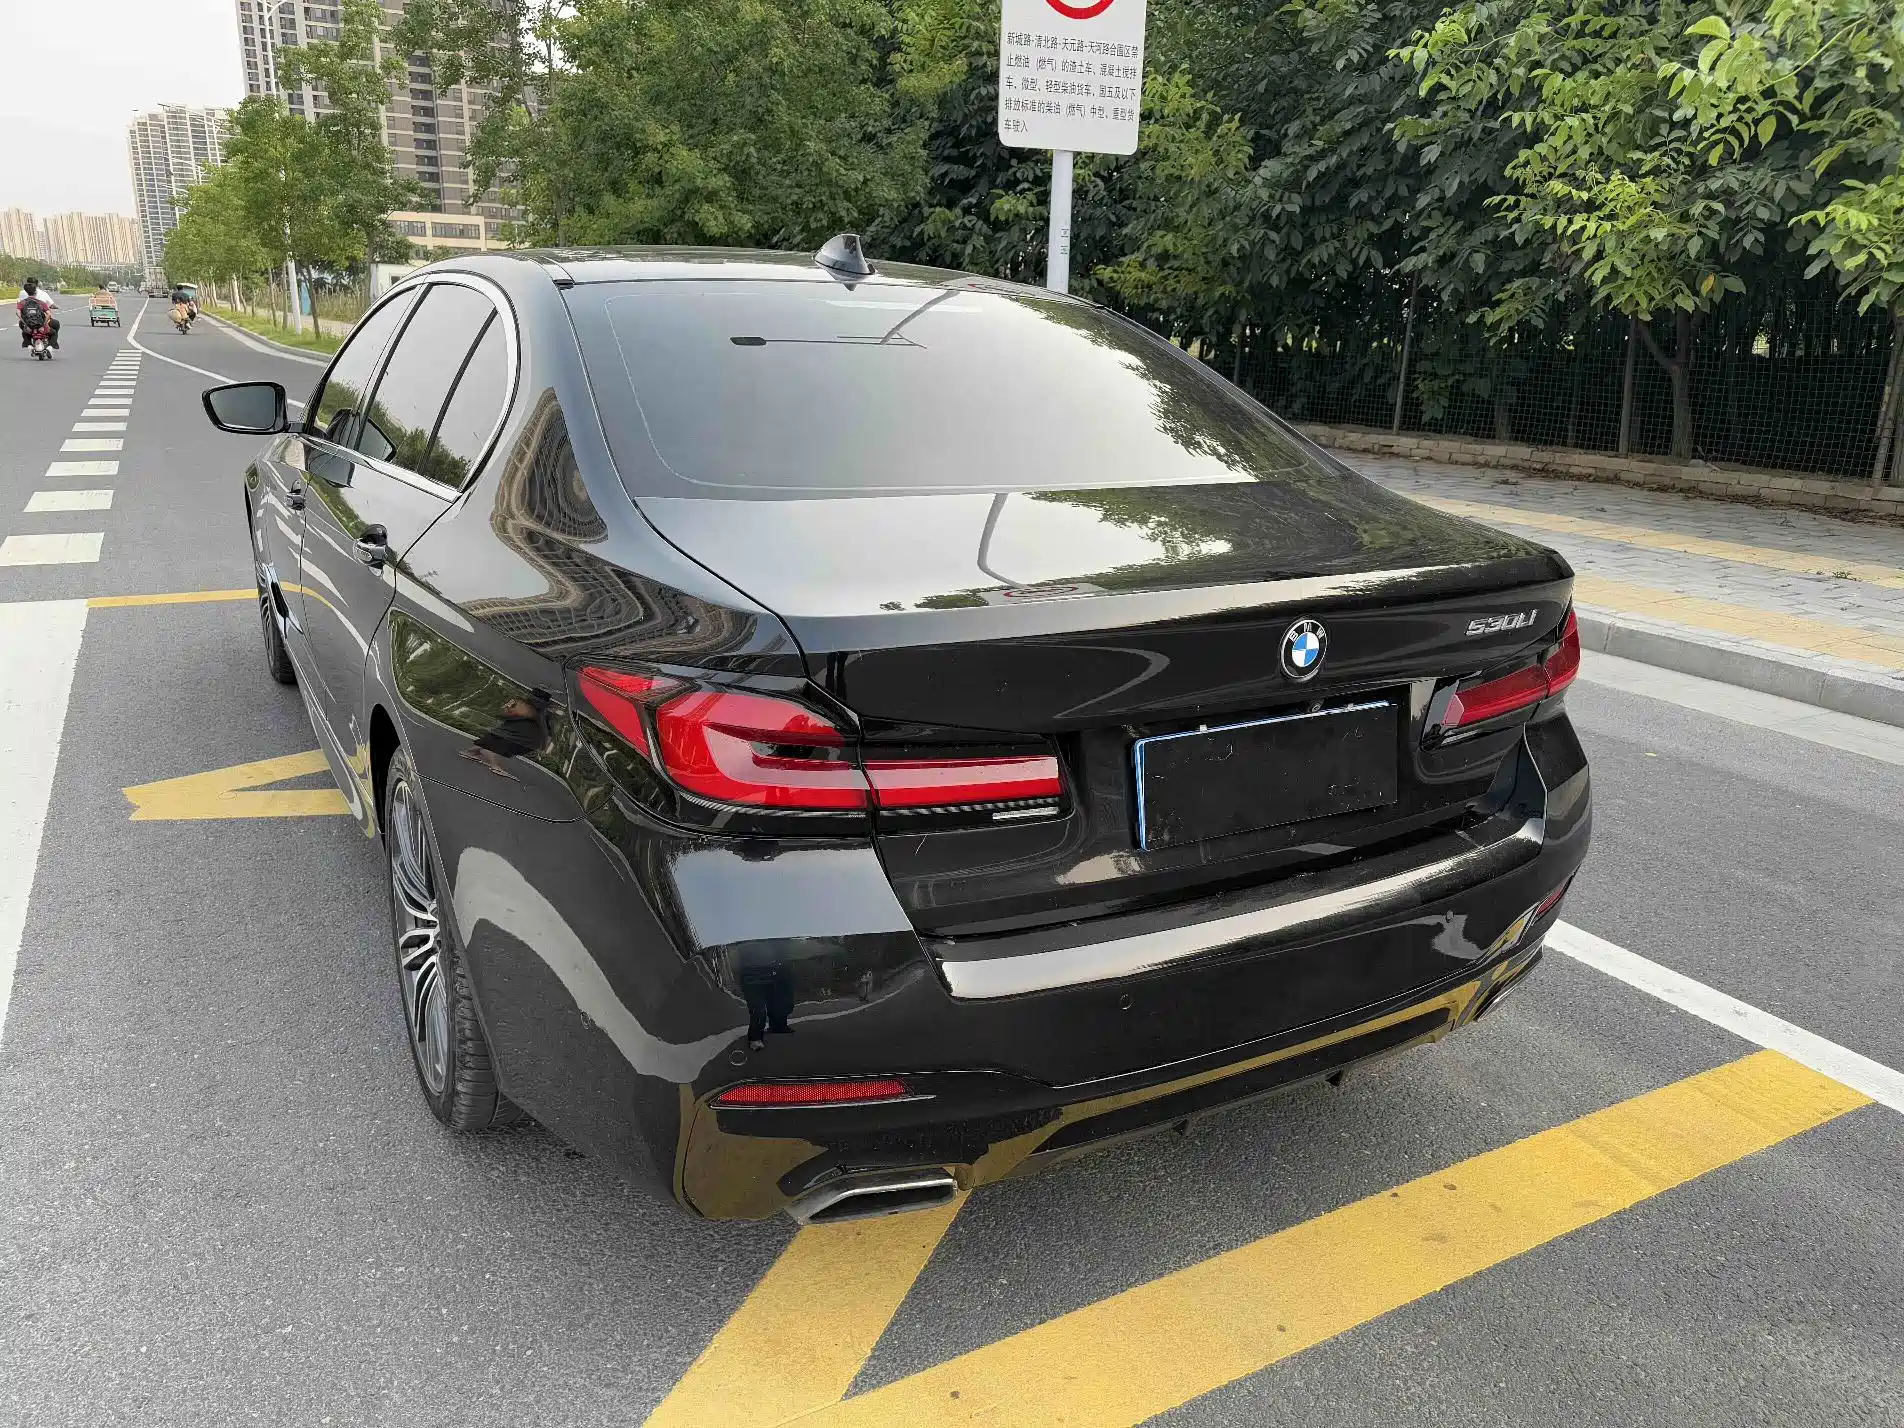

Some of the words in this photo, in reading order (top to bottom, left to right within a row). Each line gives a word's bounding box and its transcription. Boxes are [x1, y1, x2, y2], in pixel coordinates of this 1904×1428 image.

[1004, 119, 1029, 133] 车驶入
[1288, 622, 1325, 642] BMW
[1465, 609, 1538, 636] 530Li
